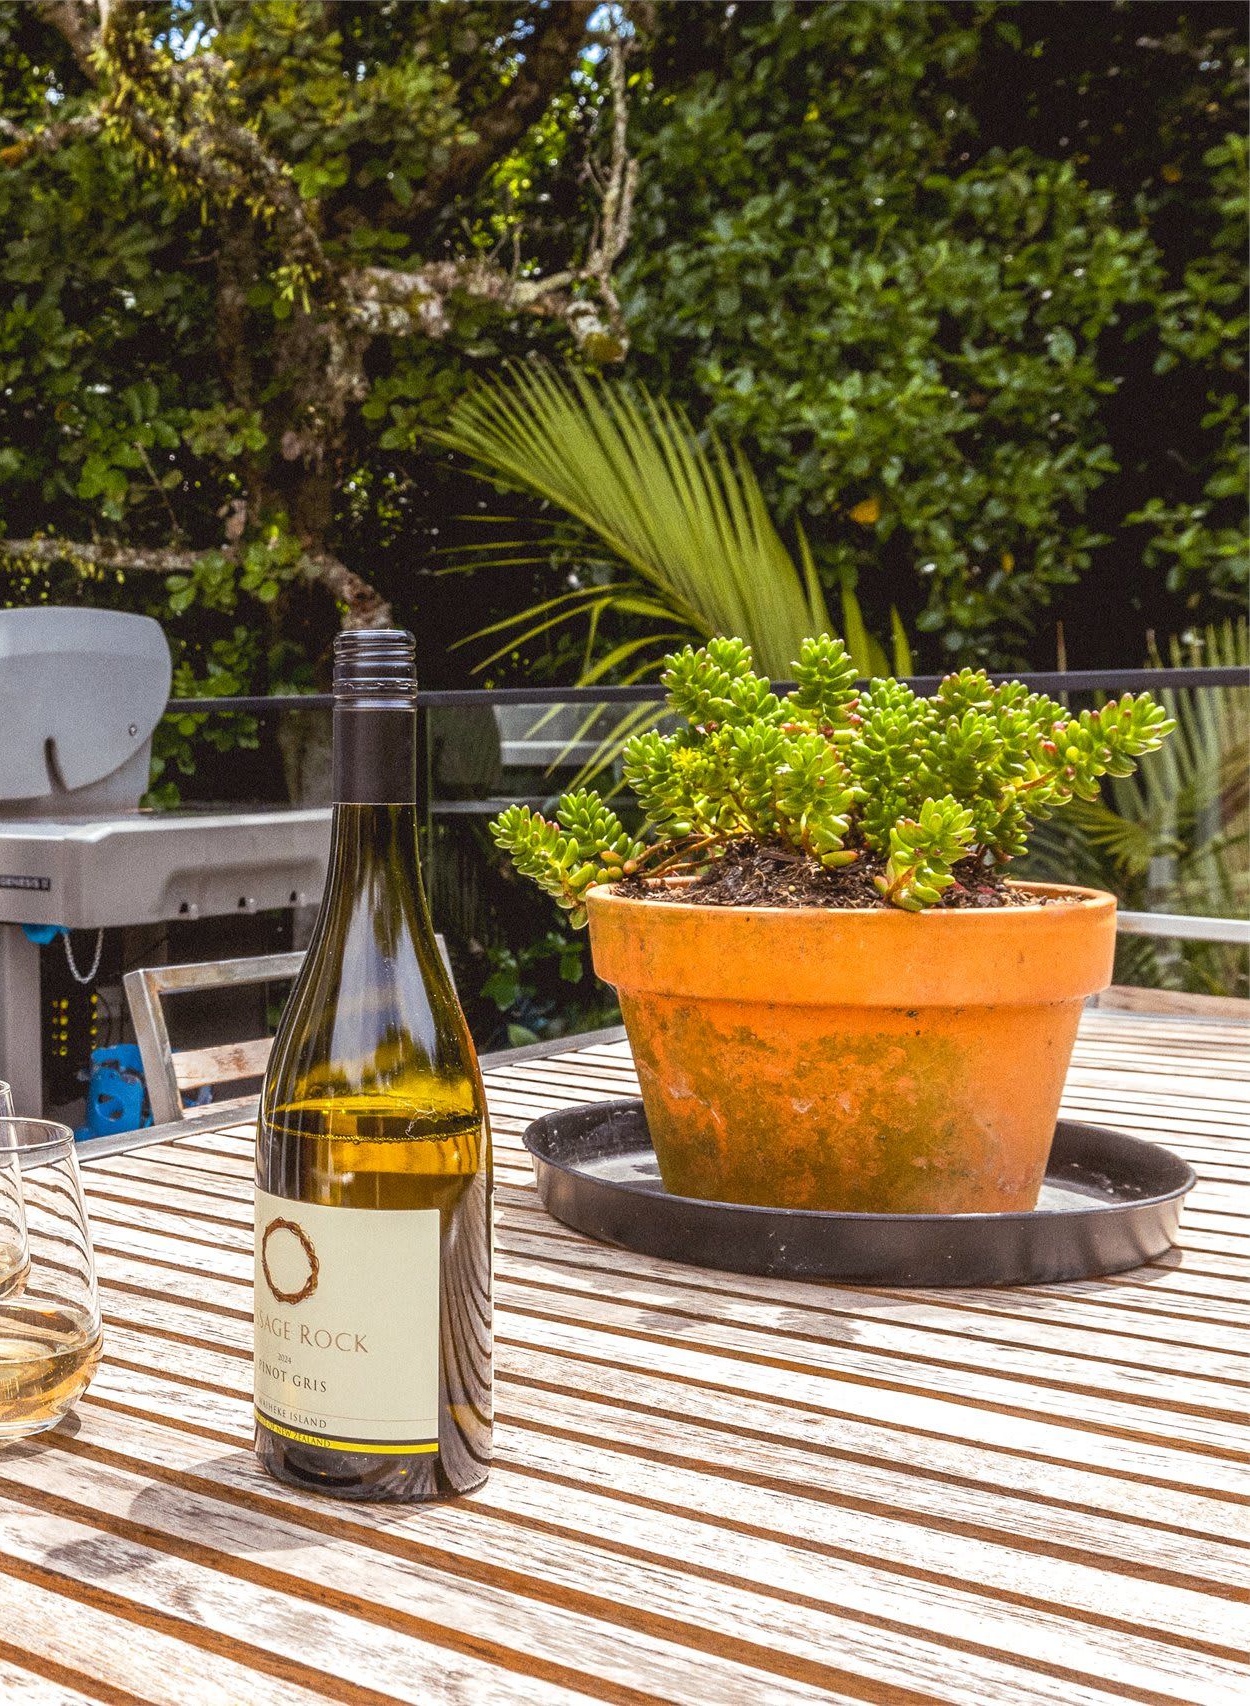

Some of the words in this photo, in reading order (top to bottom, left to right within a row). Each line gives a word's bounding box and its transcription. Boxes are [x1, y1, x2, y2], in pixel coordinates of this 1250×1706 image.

[300, 1323, 368, 1353] ROCK
[258, 1359, 287, 1382] PINOT
[292, 1374, 327, 1393] GRIS
[290, 1411, 327, 1429] ISLAND
[293, 1431, 331, 1448] ZEALAND
